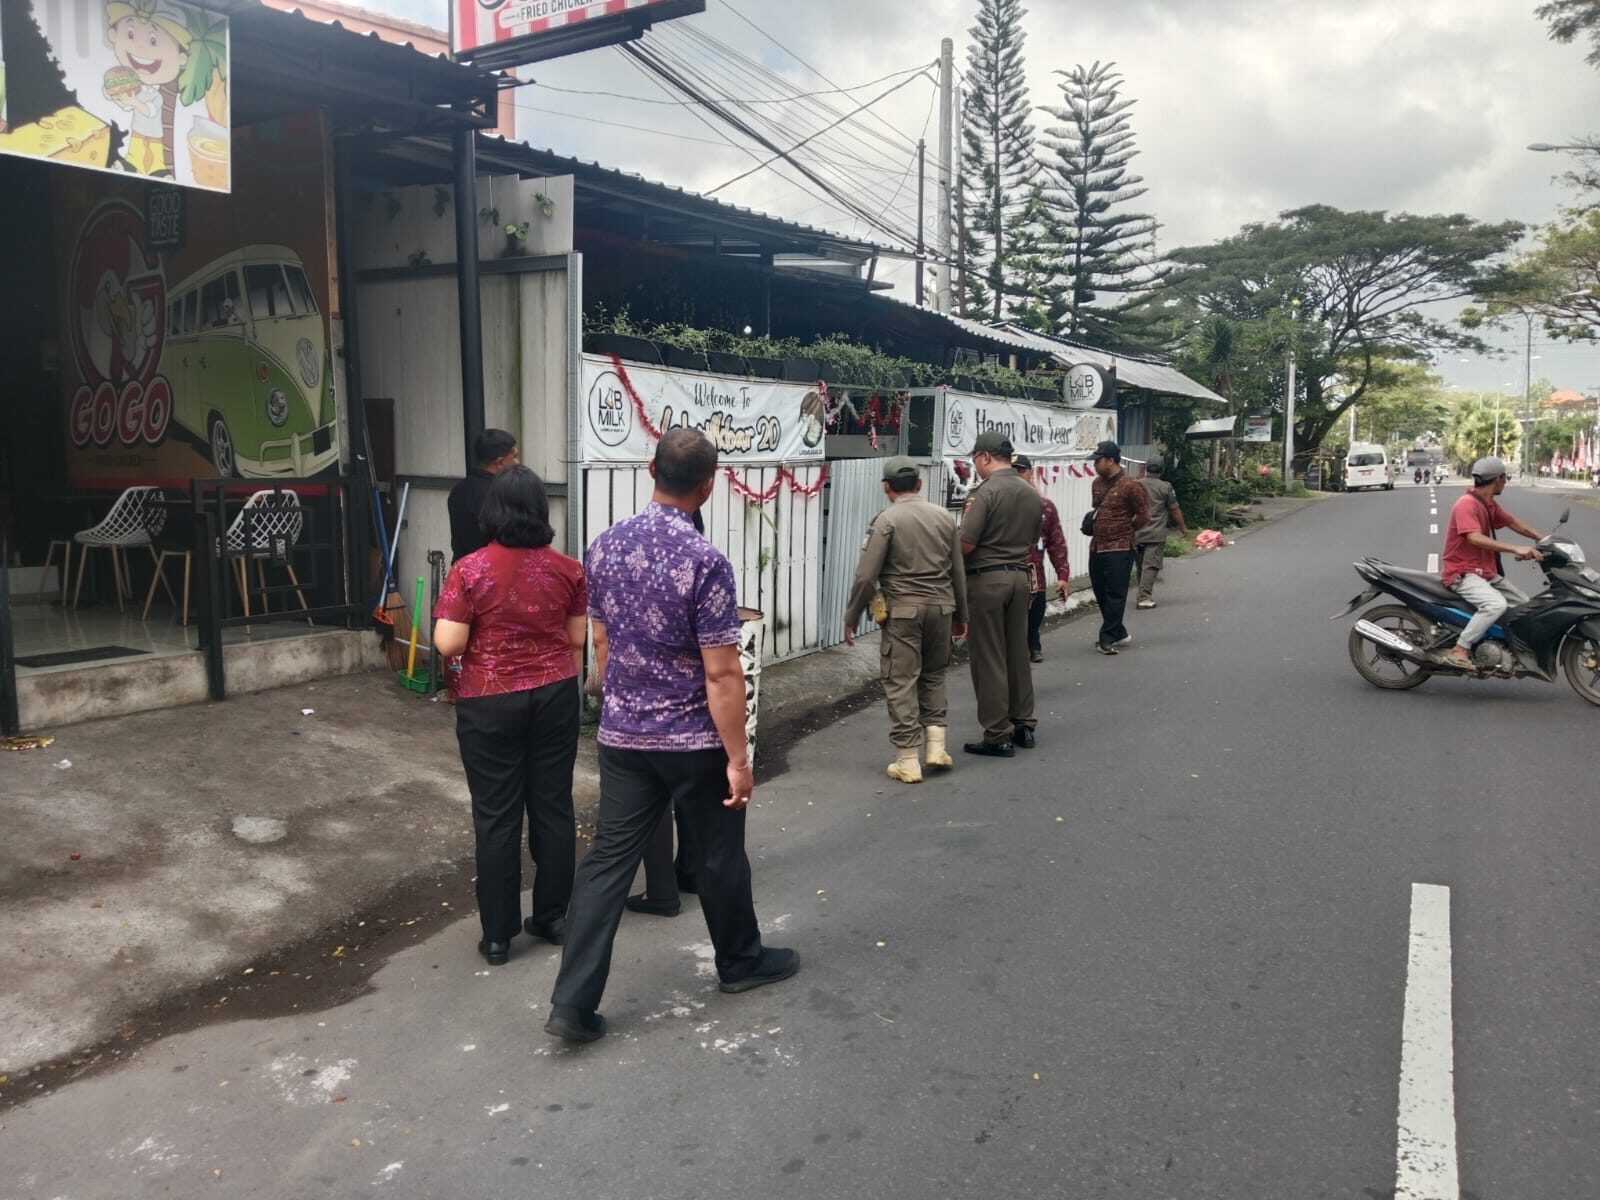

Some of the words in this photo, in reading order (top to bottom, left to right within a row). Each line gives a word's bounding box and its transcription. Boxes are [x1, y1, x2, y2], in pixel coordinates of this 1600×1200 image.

[521, 1, 548, 21] FRIED
[551, 0, 593, 13] CHICK
[151, 191, 180, 216] GOOD
[150, 215, 180, 239] TASTE
[694, 382, 737, 409] Welcome
[739, 387, 752, 410] To
[1071, 387, 1095, 398] MILK
[70, 376, 172, 445] GOGO
[598, 409, 626, 427] MILK
[756, 415, 782, 453] 20
